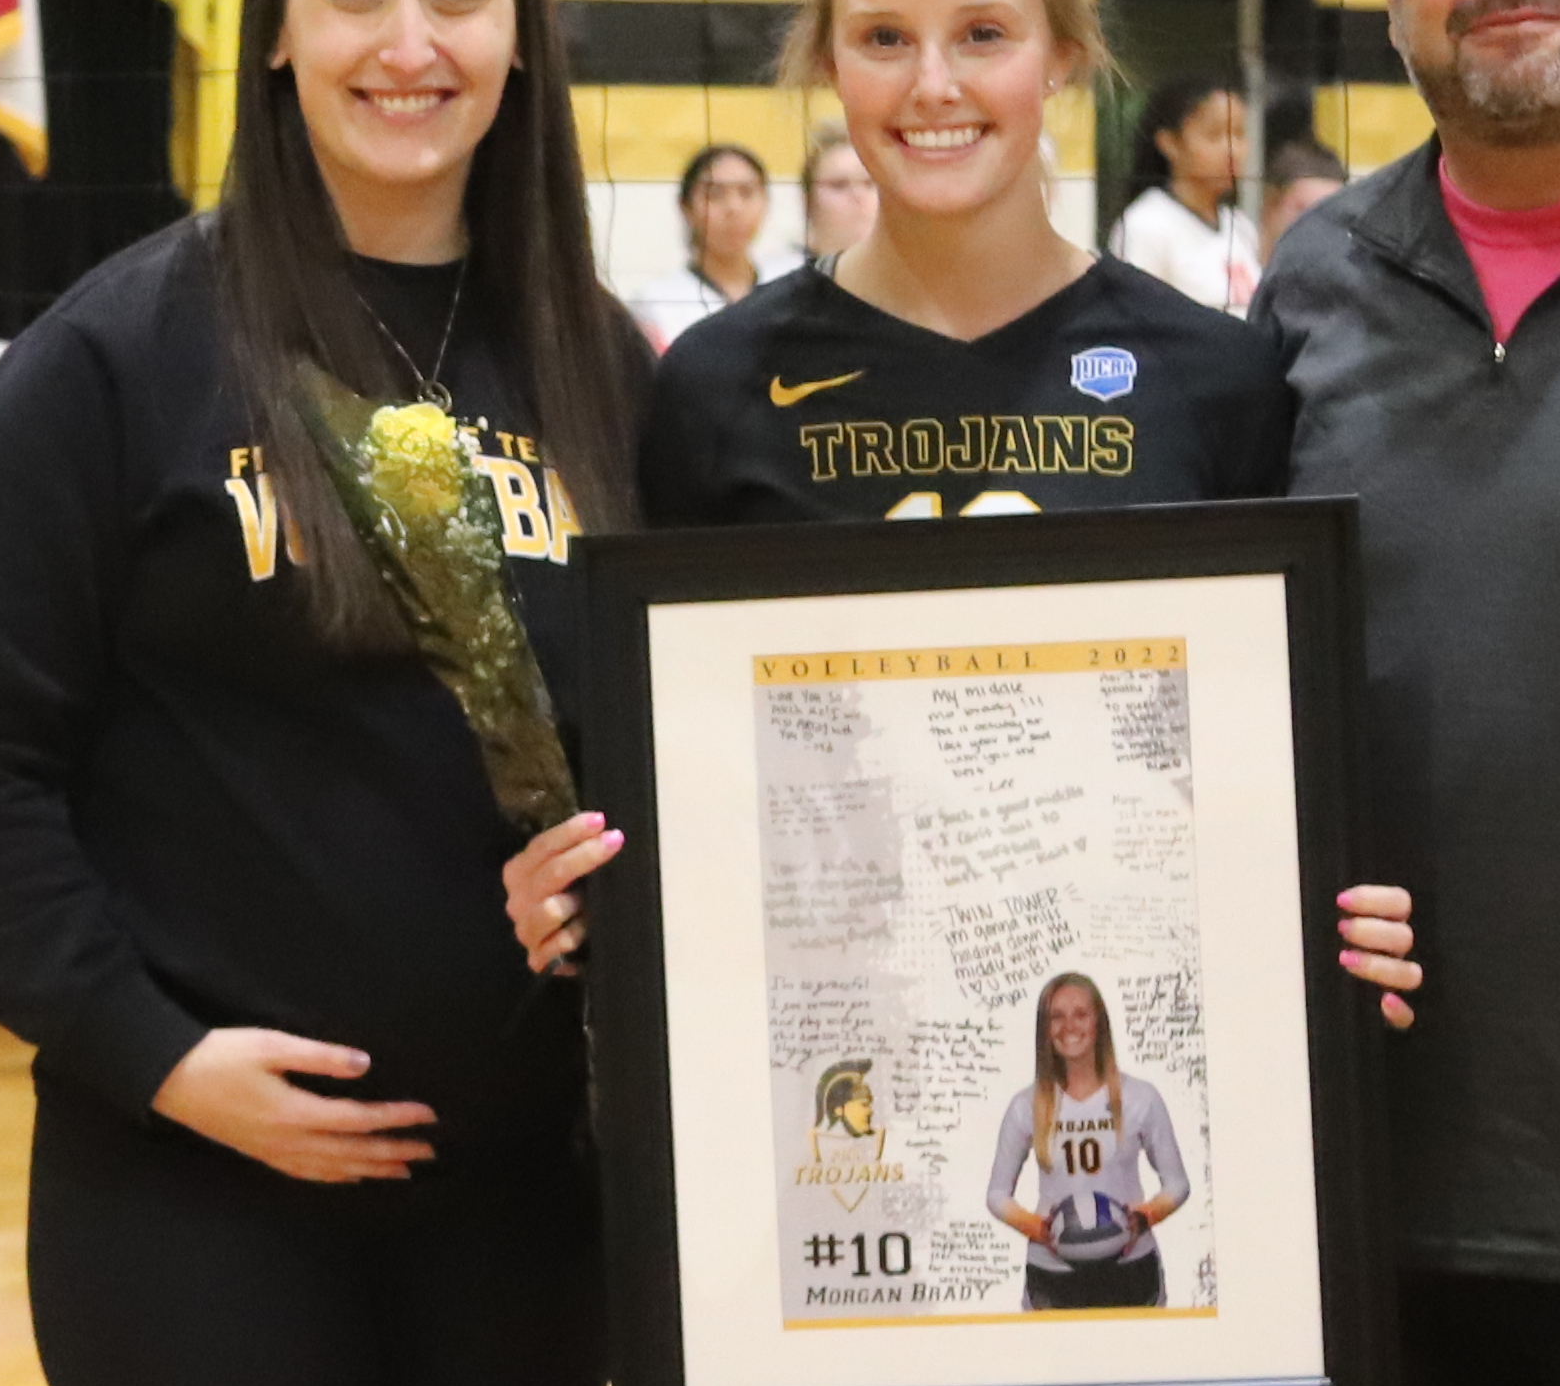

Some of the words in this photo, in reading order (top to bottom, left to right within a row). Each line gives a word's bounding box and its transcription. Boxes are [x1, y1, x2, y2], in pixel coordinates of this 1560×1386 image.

[799, 415, 1135, 482] TROJANS
[762, 650, 1037, 679] VOLLEYBALL
[1090, 646, 1179, 665] 2022
[939, 901, 994, 928] TWIN
[998, 887, 1064, 918] TOWER
[950, 940, 1006, 965] holding
[1007, 927, 1045, 951] down
[974, 917, 1020, 942] gonna
[1008, 943, 1045, 966] with
[1055, 1118, 1115, 1133] ROJAN
[795, 1162, 904, 1186] TROJANS
[1062, 1137, 1101, 1176] 10
[803, 1231, 912, 1277] #10
